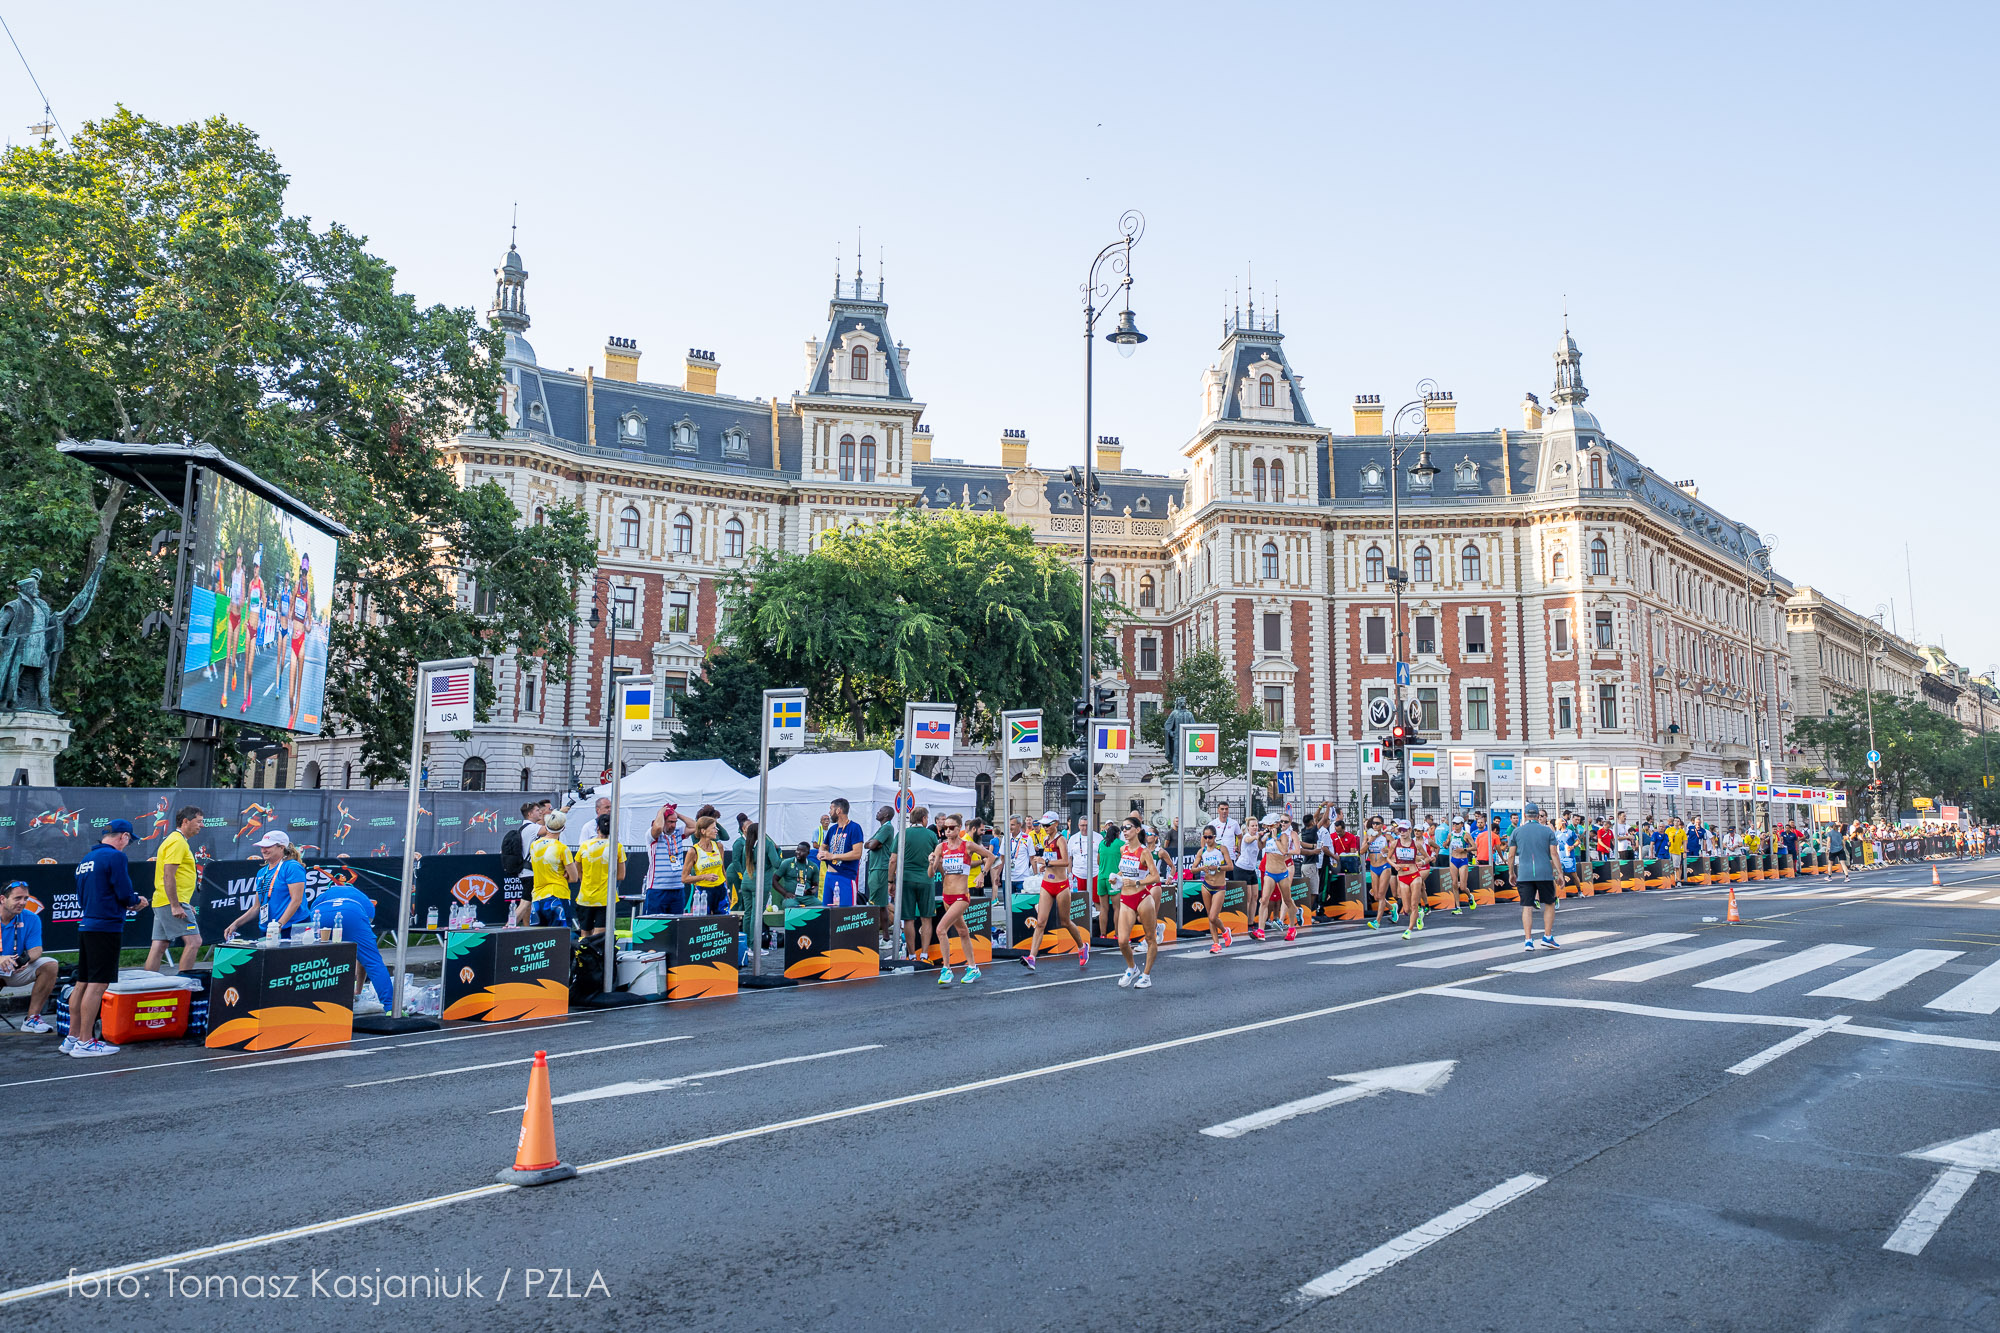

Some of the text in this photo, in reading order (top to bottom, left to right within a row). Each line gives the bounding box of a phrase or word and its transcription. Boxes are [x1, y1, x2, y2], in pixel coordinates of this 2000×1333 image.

[441, 712, 458, 722] USA
[630, 724, 642, 732] UKR
[76, 861, 94, 875] USA
[211, 897, 236, 909] THE
[968, 901, 990, 911] THROUGH
[851, 912, 867, 921] RACE
[699, 924, 718, 934] TAKE
[836, 917, 874, 933] AWAITS YOU!
[696, 932, 729, 943] BREATH...
[713, 937, 732, 947] SOAR
[514, 940, 556, 955] IT'S YOUR
[523, 951, 545, 962] TIME
[690, 946, 727, 962] TO GLORY!
[290, 957, 329, 974] READY,
[519, 959, 550, 973] SHINE!
[268, 963, 350, 989] SET, CONQUER
[295, 976, 339, 991] AND WIN!
